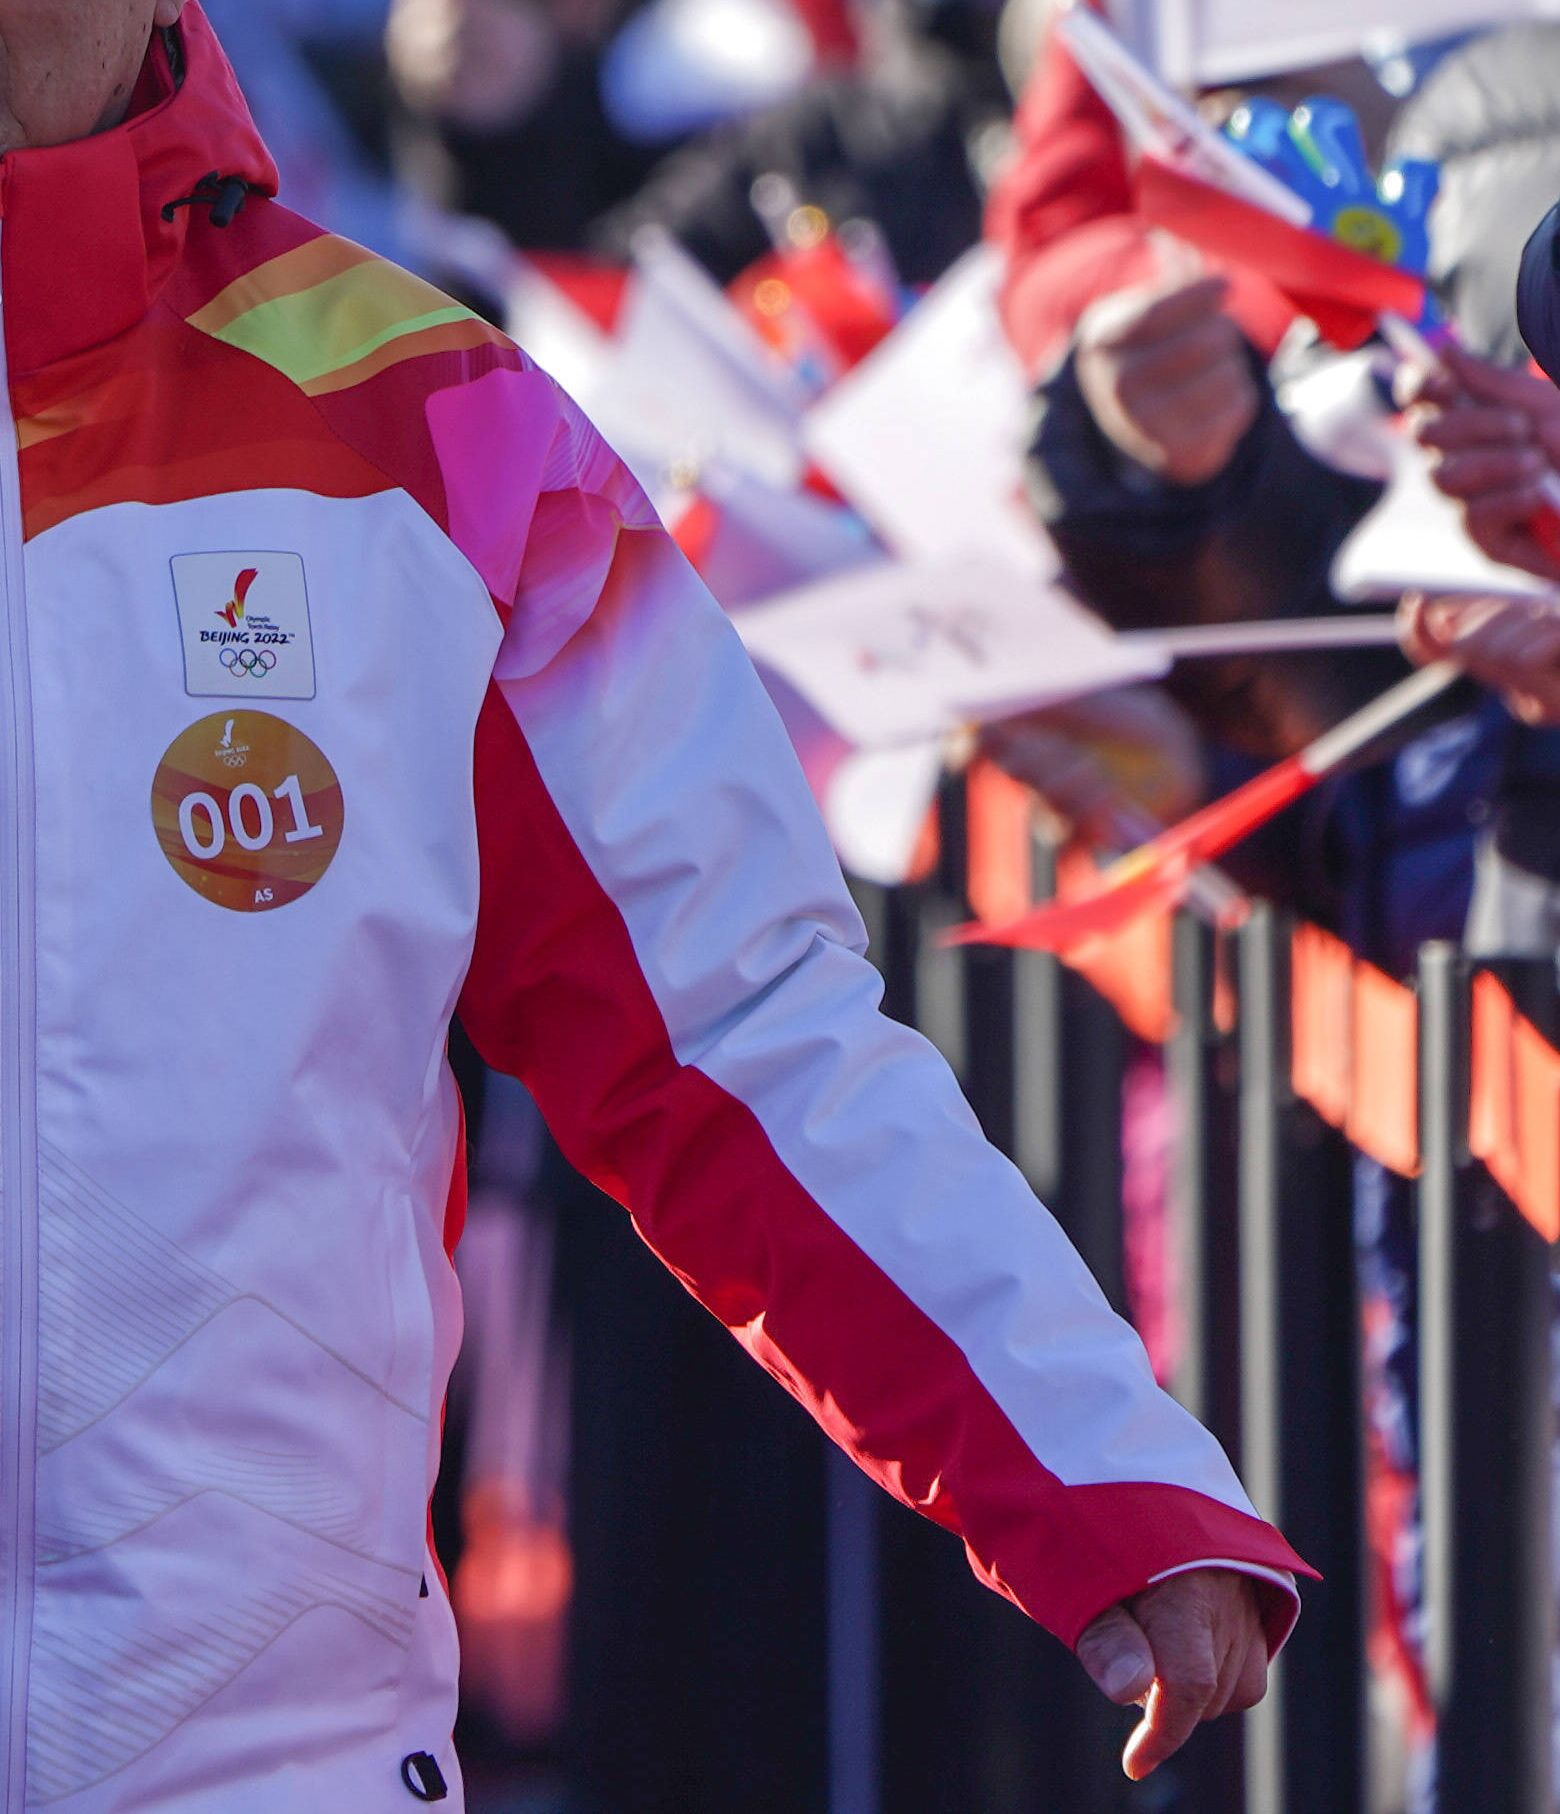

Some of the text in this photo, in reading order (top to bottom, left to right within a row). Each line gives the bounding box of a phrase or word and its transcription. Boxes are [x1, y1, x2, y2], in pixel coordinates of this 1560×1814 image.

[199, 630, 250, 646] BEIJING
[178, 774, 324, 860] 001
[254, 888, 274, 904] AS
